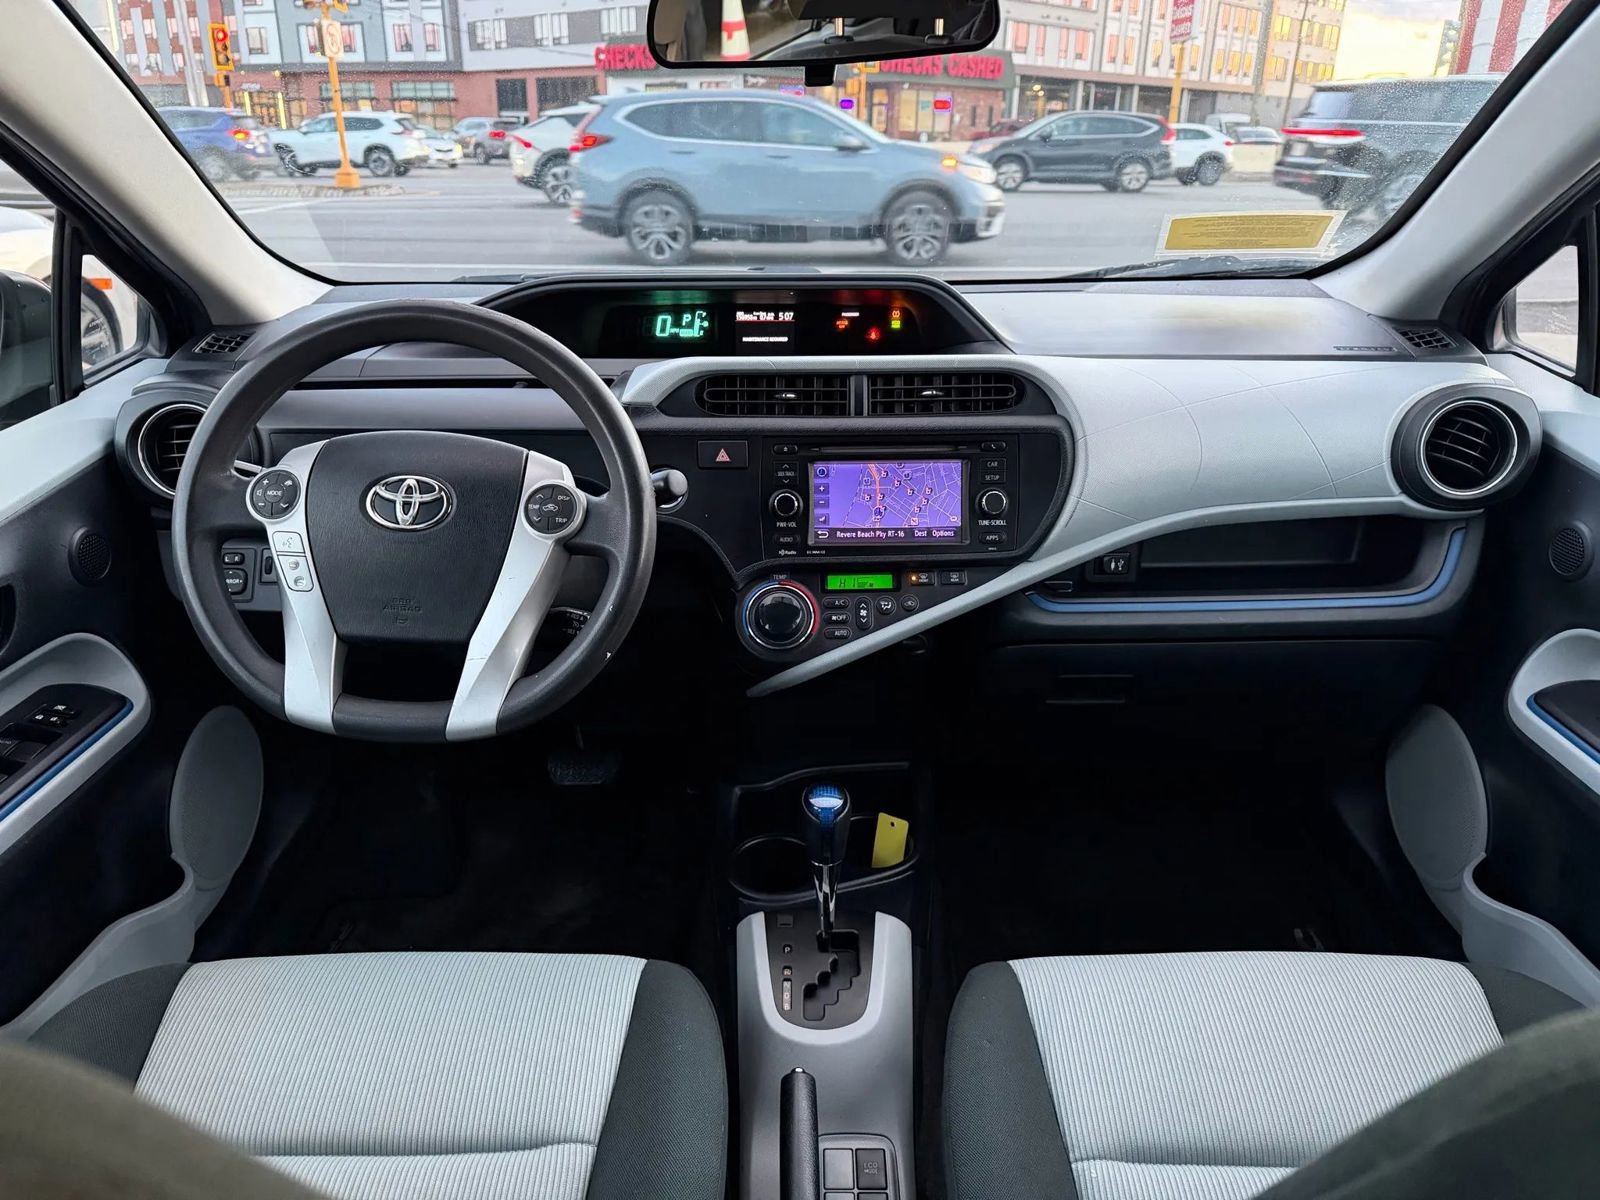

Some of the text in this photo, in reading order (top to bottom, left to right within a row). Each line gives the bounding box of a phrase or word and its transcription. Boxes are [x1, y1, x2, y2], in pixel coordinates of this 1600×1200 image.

[948, 54, 1003, 80] CASHED
[682, 313, 691, 326] P
[932, 529, 954, 537] Options
[784, 946, 791, 954] P
[863, 1161, 878, 1169] ECO
